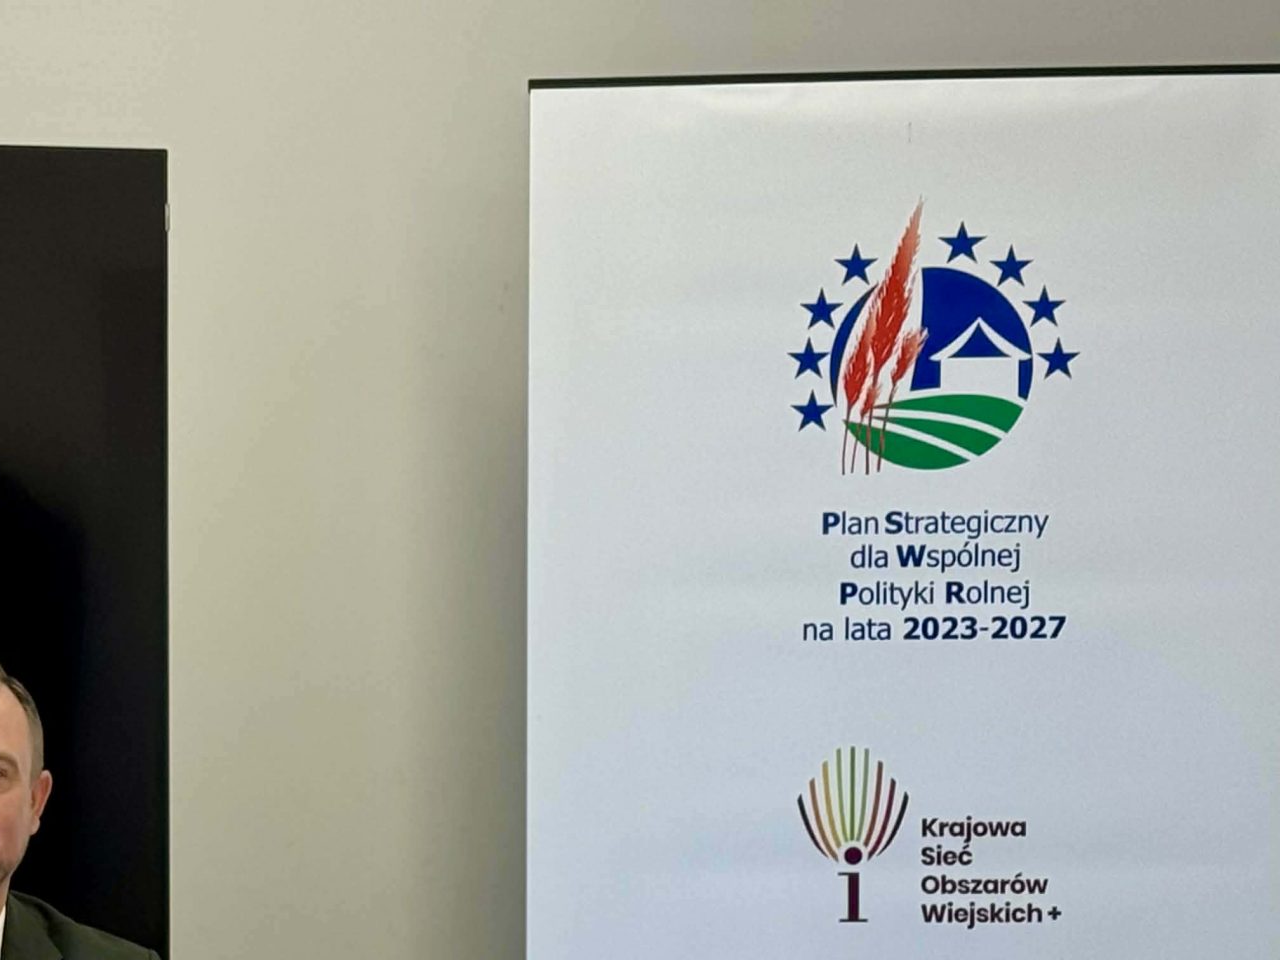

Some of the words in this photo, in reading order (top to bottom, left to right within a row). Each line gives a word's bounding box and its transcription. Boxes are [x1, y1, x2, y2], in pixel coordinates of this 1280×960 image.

[822, 511, 879, 535] Plan
[885, 510, 1049, 539] Strategiczny
[850, 544, 888, 569] dla
[896, 542, 1021, 573] Wspólnej
[839, 580, 935, 611] Polityki
[945, 580, 1031, 609] Rolnej
[802, 622, 834, 641] na
[844, 616, 892, 641] lata
[903, 615, 1067, 640] 2023-2027
[921, 816, 1027, 845] Krajowa
[921, 844, 973, 866] Sieć
[921, 872, 1049, 895] Obszarów
